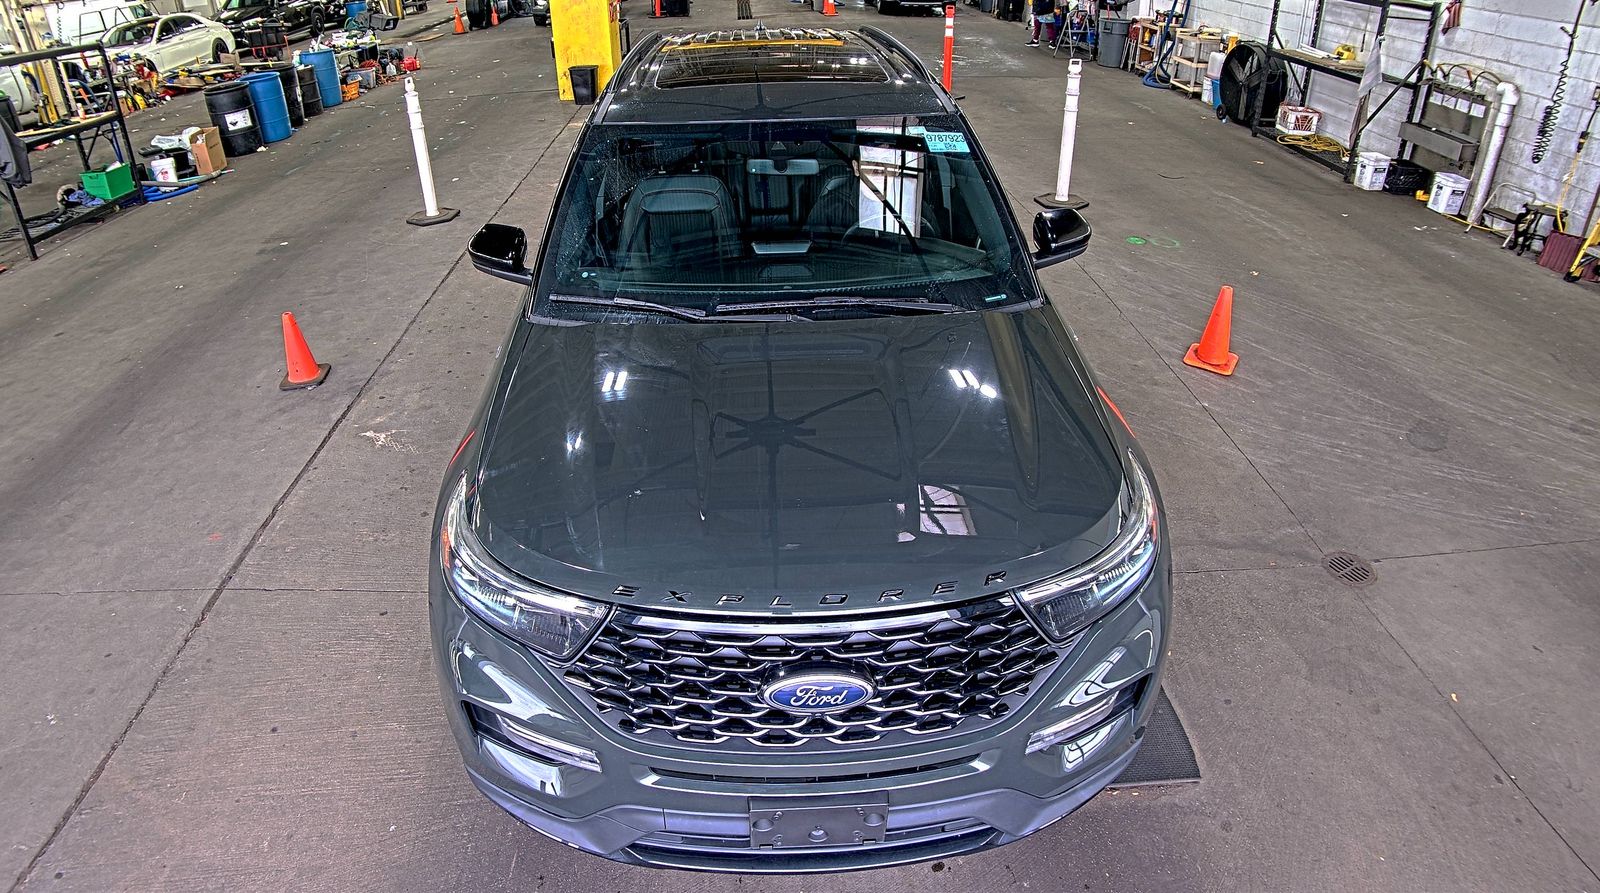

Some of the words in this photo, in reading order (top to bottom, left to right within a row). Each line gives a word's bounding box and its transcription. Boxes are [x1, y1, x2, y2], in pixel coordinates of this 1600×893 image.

[926, 134, 965, 143] 9787923
[612, 570, 1007, 607] EXPLORER
[790, 685, 848, 706] Ford
